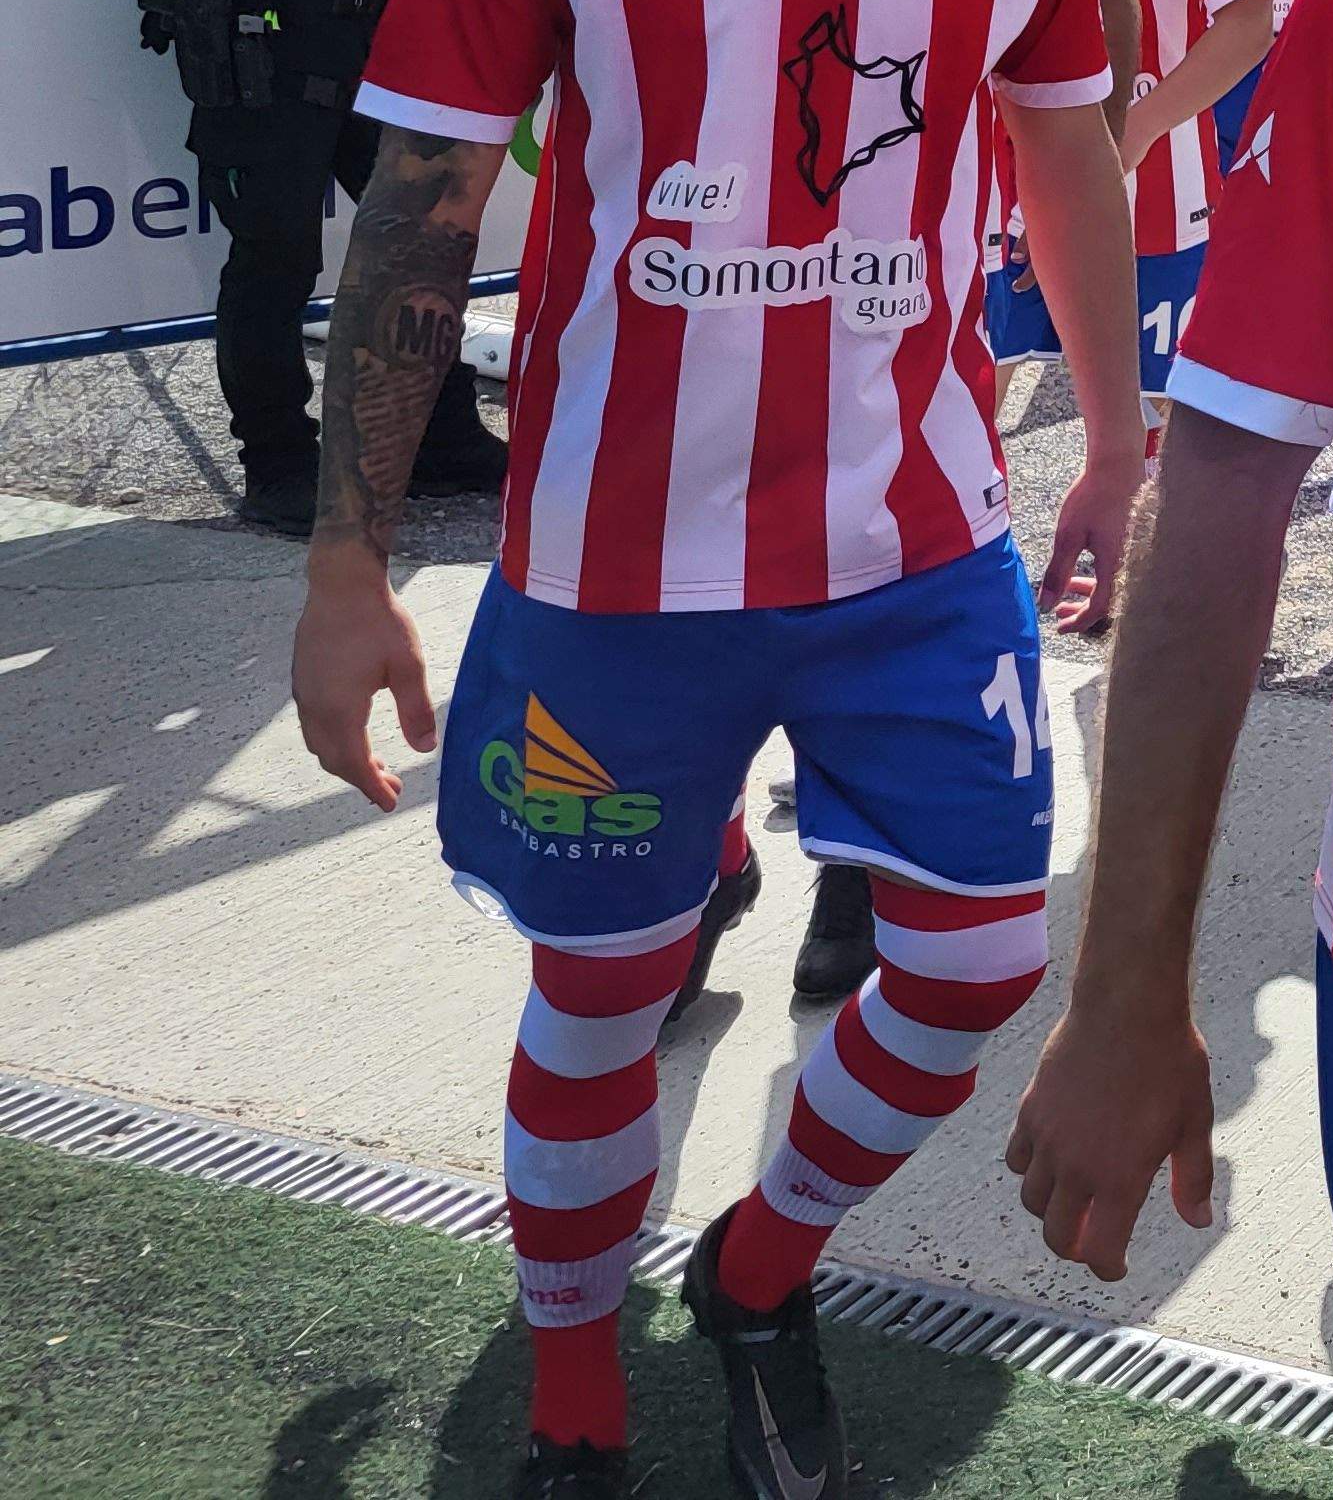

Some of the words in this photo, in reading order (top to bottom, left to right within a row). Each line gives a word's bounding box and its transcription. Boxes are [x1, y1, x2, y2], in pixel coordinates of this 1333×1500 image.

[656, 176, 736, 210] vive!
[643, 241, 924, 297] Somontano
[479, 738, 662, 837] Gas
